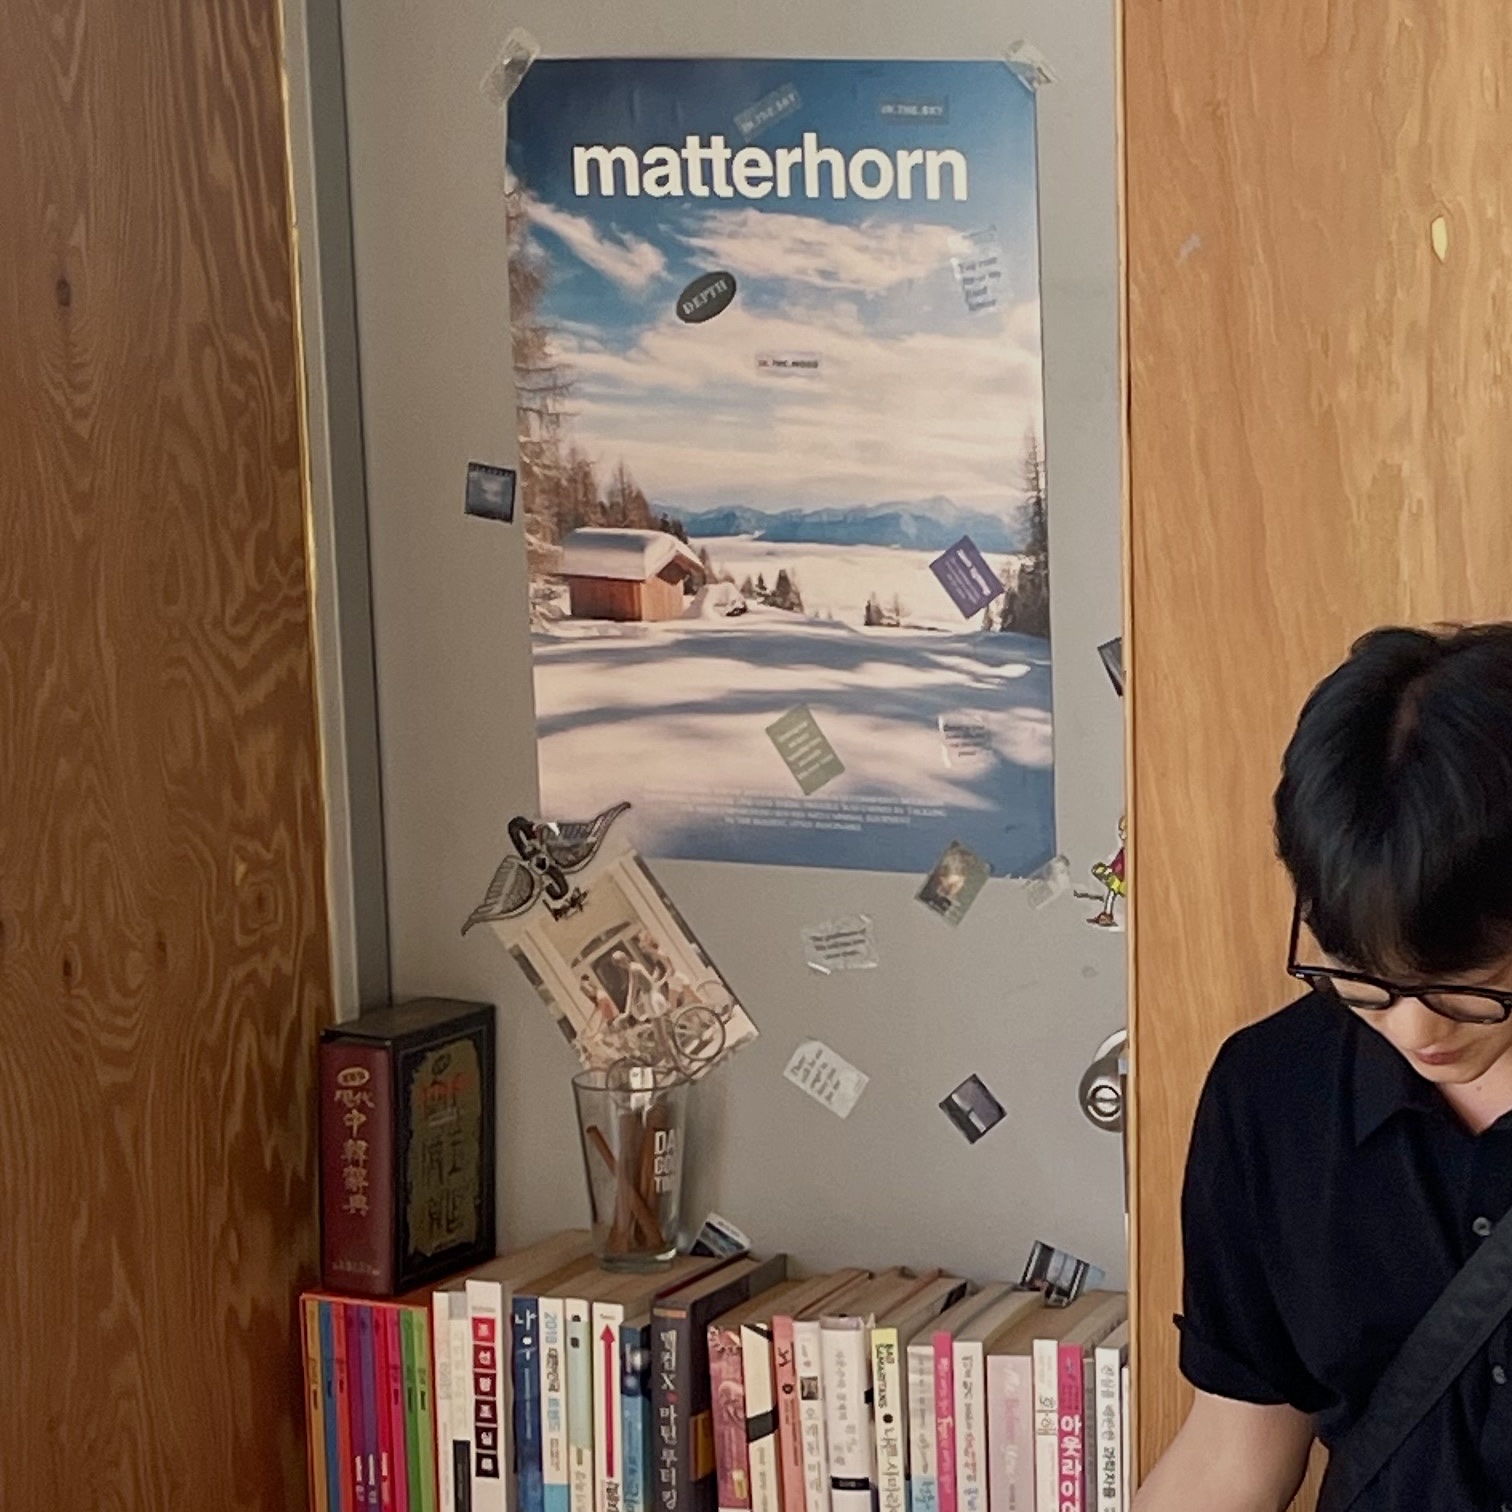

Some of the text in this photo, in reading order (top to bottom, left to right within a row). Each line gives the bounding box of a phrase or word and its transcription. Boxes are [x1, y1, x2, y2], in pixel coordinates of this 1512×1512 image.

[572, 132, 969, 201] matterhorn
[682, 279, 728, 315] DEPTH
[880, 1427, 898, 1459] 나쁜
[1102, 1446, 1118, 1500] 과학자들
